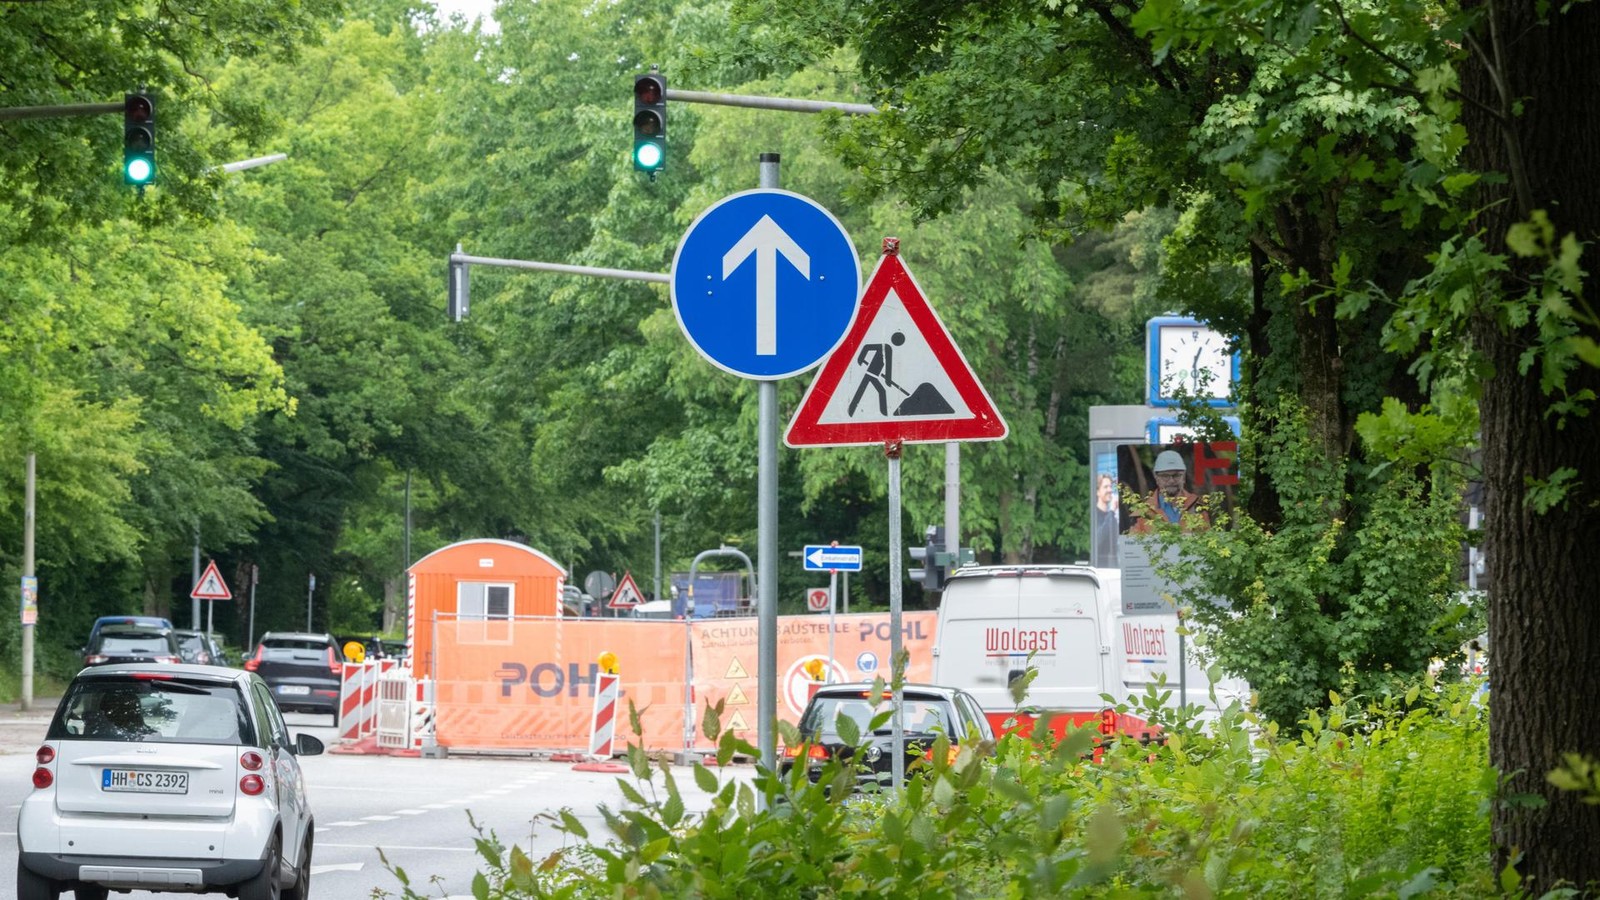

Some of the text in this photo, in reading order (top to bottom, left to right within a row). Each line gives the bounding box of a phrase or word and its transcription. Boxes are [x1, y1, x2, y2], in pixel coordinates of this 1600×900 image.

[701, 627, 758, 639] ACHTUN
[986, 627, 1058, 651] Wolgast
[1123, 622, 1167, 656] Wolgast
[501, 662, 626, 698] POH
[112, 772, 128, 786] HH
[136, 773, 153, 787] CS
[155, 774, 186, 788] 2392
